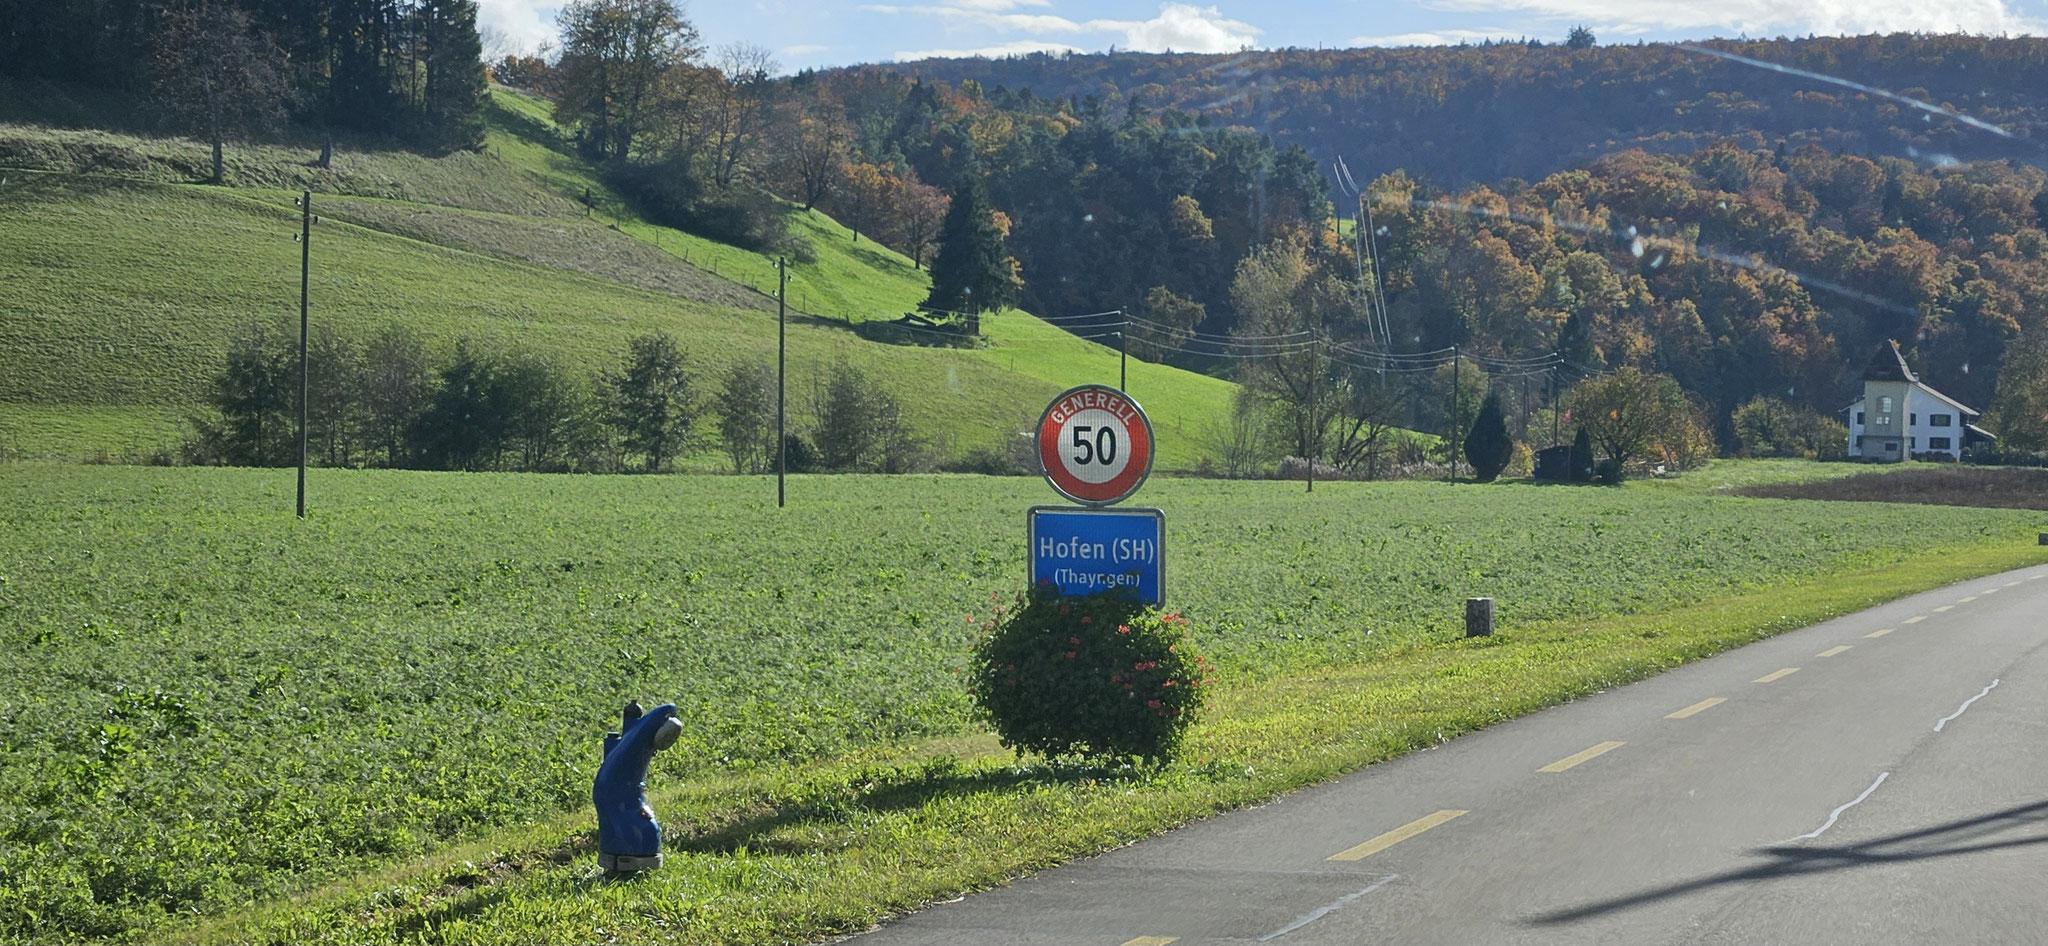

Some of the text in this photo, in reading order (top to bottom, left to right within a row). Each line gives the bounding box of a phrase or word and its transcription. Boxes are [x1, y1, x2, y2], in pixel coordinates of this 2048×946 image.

[1050, 391, 1135, 427] GENERELL
[1073, 425, 1117, 466] 50
[1040, 535, 1154, 564] Hofen (SH)
